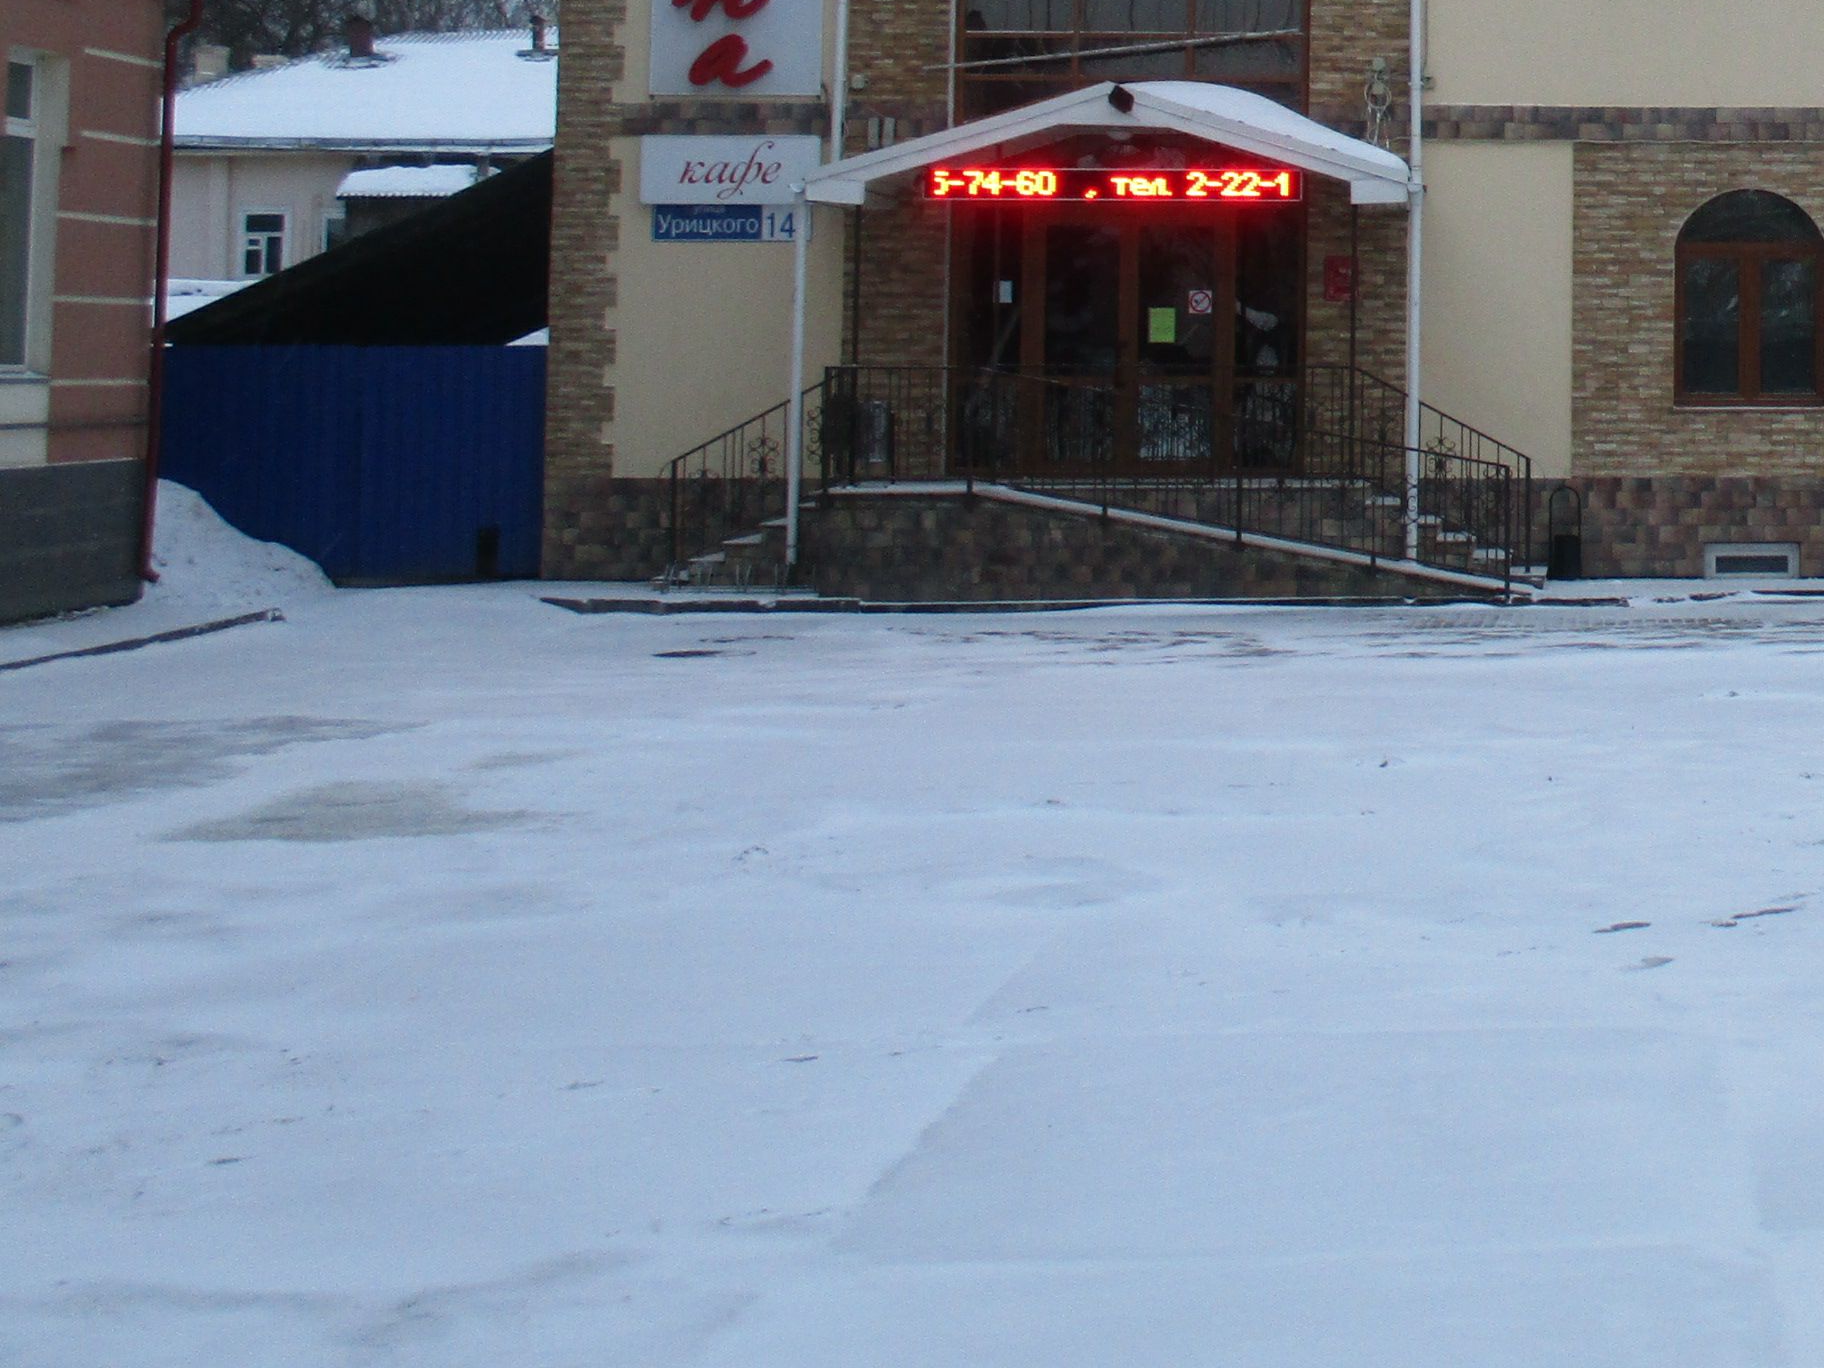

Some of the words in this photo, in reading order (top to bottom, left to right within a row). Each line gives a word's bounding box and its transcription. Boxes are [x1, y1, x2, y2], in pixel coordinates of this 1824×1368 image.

[678, 140, 782, 200] кафе
[1110, 176, 1173, 197] тел.
[1186, 171, 1290, 197] 2-22-1
[657, 214, 760, 237] Урицкого
[766, 212, 796, 239] 14
